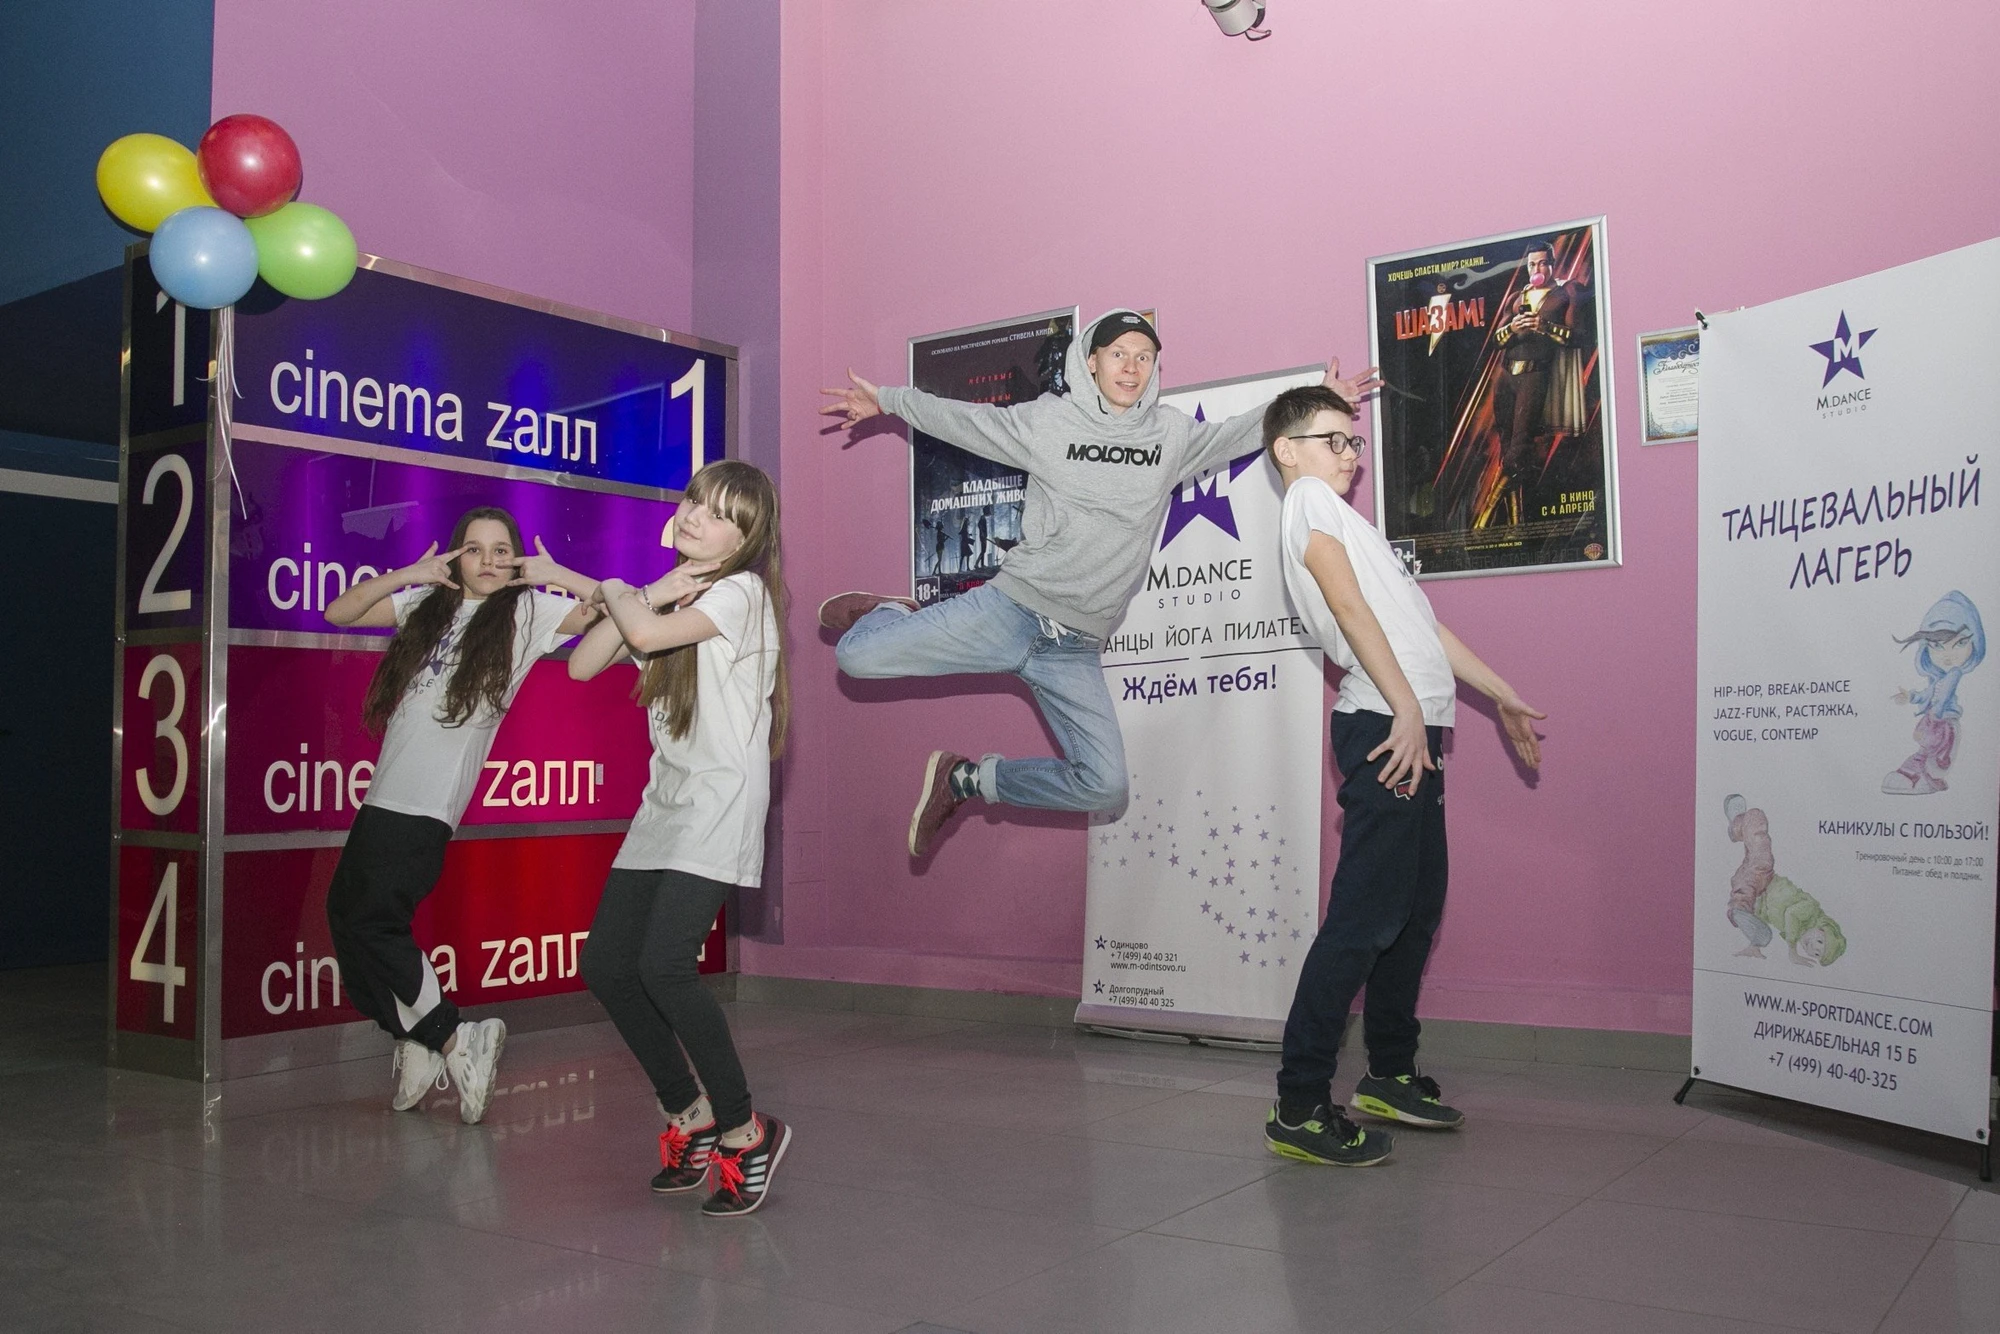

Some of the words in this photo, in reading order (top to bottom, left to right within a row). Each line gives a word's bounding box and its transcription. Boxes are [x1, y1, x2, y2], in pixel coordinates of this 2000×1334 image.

[1388, 270, 1414, 282] ХОЧЕШЬ
[1414, 264, 1440, 277] СПАСТИ
[1441, 262, 1459, 272] МИР?
[1395, 297, 1485, 340] ШАЗАМ!
[1009, 331, 1035, 342] СТИВЕНА
[1035, 327, 1054, 337] КИНГА
[155, 290, 187, 407] 1
[1817, 388, 1871, 411] M.DANCE
[270, 349, 463, 442] cinema
[670, 358, 704, 478] 1
[1822, 404, 1867, 419] STUDIO
[962, 474, 1023, 494] КЛАДБИЩЕ
[930, 491, 994, 515] ДОМАШНИХ
[995, 488, 1027, 504] ЖИВО
[1560, 493, 1567, 503] В
[1569, 490, 1594, 502] КИНО
[1722, 454, 1981, 543] ТАНЦЕВАЛЬНЫЙ
[1541, 506, 1548, 517] С
[1550, 505, 1556, 515] 4
[1559, 500, 1595, 515] АПРЕЛЯ
[138, 454, 194, 614] 2
[1790, 538, 1912, 590] ЛАГЕРЬ
[1147, 558, 1253, 592] M.DANCE
[917, 583, 938, 601] 18+
[1158, 588, 1241, 609] STUDIO
[1103, 632, 1153, 655] АНЦЫ
[1166, 625, 1213, 648] ЙОГА
[1122, 673, 1198, 704] Ждём
[1207, 664, 1277, 694] тебя!
[1714, 684, 1763, 699] HIP-HOP,
[1768, 680, 1851, 696] BREAK-DANCE
[1713, 705, 1781, 720] JAZZ-FUNK,
[1785, 704, 1858, 718] РАСТЯЖКА,
[135, 654, 188, 816] 3
[1713, 729, 1757, 743] VOGUE,
[1761, 728, 1819, 741] CONTEMP
[264, 743, 373, 814] cine
[1818, 820, 1895, 837] КАНИКУЛЫ
[1899, 822, 1909, 838] С
[1913, 821, 1989, 841] ПОЛЬЗОЙ!
[1855, 850, 1907, 862] Тренировочный
[1908, 855, 1926, 864] день
[1933, 855, 1952, 866] 10:00
[1953, 858, 1962, 867] до
[1965, 856, 1984, 867] 17:00
[1892, 866, 1923, 877] Питание:
[1925, 868, 1943, 880] обед
[130, 862, 186, 1023] 4
[1110, 939, 1149, 951] Одинцово
[1122, 951, 1141, 961] (499)
[1142, 952, 1152, 961] 40
[1153, 953, 1163, 961] 40
[1165, 953, 1178, 961] 321
[1110, 962, 1187, 973] www.m-odintsovo.ru
[1109, 984, 1165, 997] Долгопрудный
[1108, 996, 1118, 1004] +7
[1118, 996, 1138, 1006] (499)
[1138, 997, 1148, 1006] 40
[1149, 997, 1159, 1006] 40
[1160, 998, 1175, 1008] 325
[1744, 991, 1933, 1037] WWW.M-SPORTDANCE.COM
[1753, 1021, 1880, 1058] ДИРИЖАБЕЛЬНАЯ
[1886, 1044, 1902, 1062] 15
[1908, 1048, 1917, 1064] Б
[1768, 1052, 1784, 1067] +7
[1788, 1056, 1822, 1078] (499)
[1826, 1064, 1898, 1091] 40-40-325
